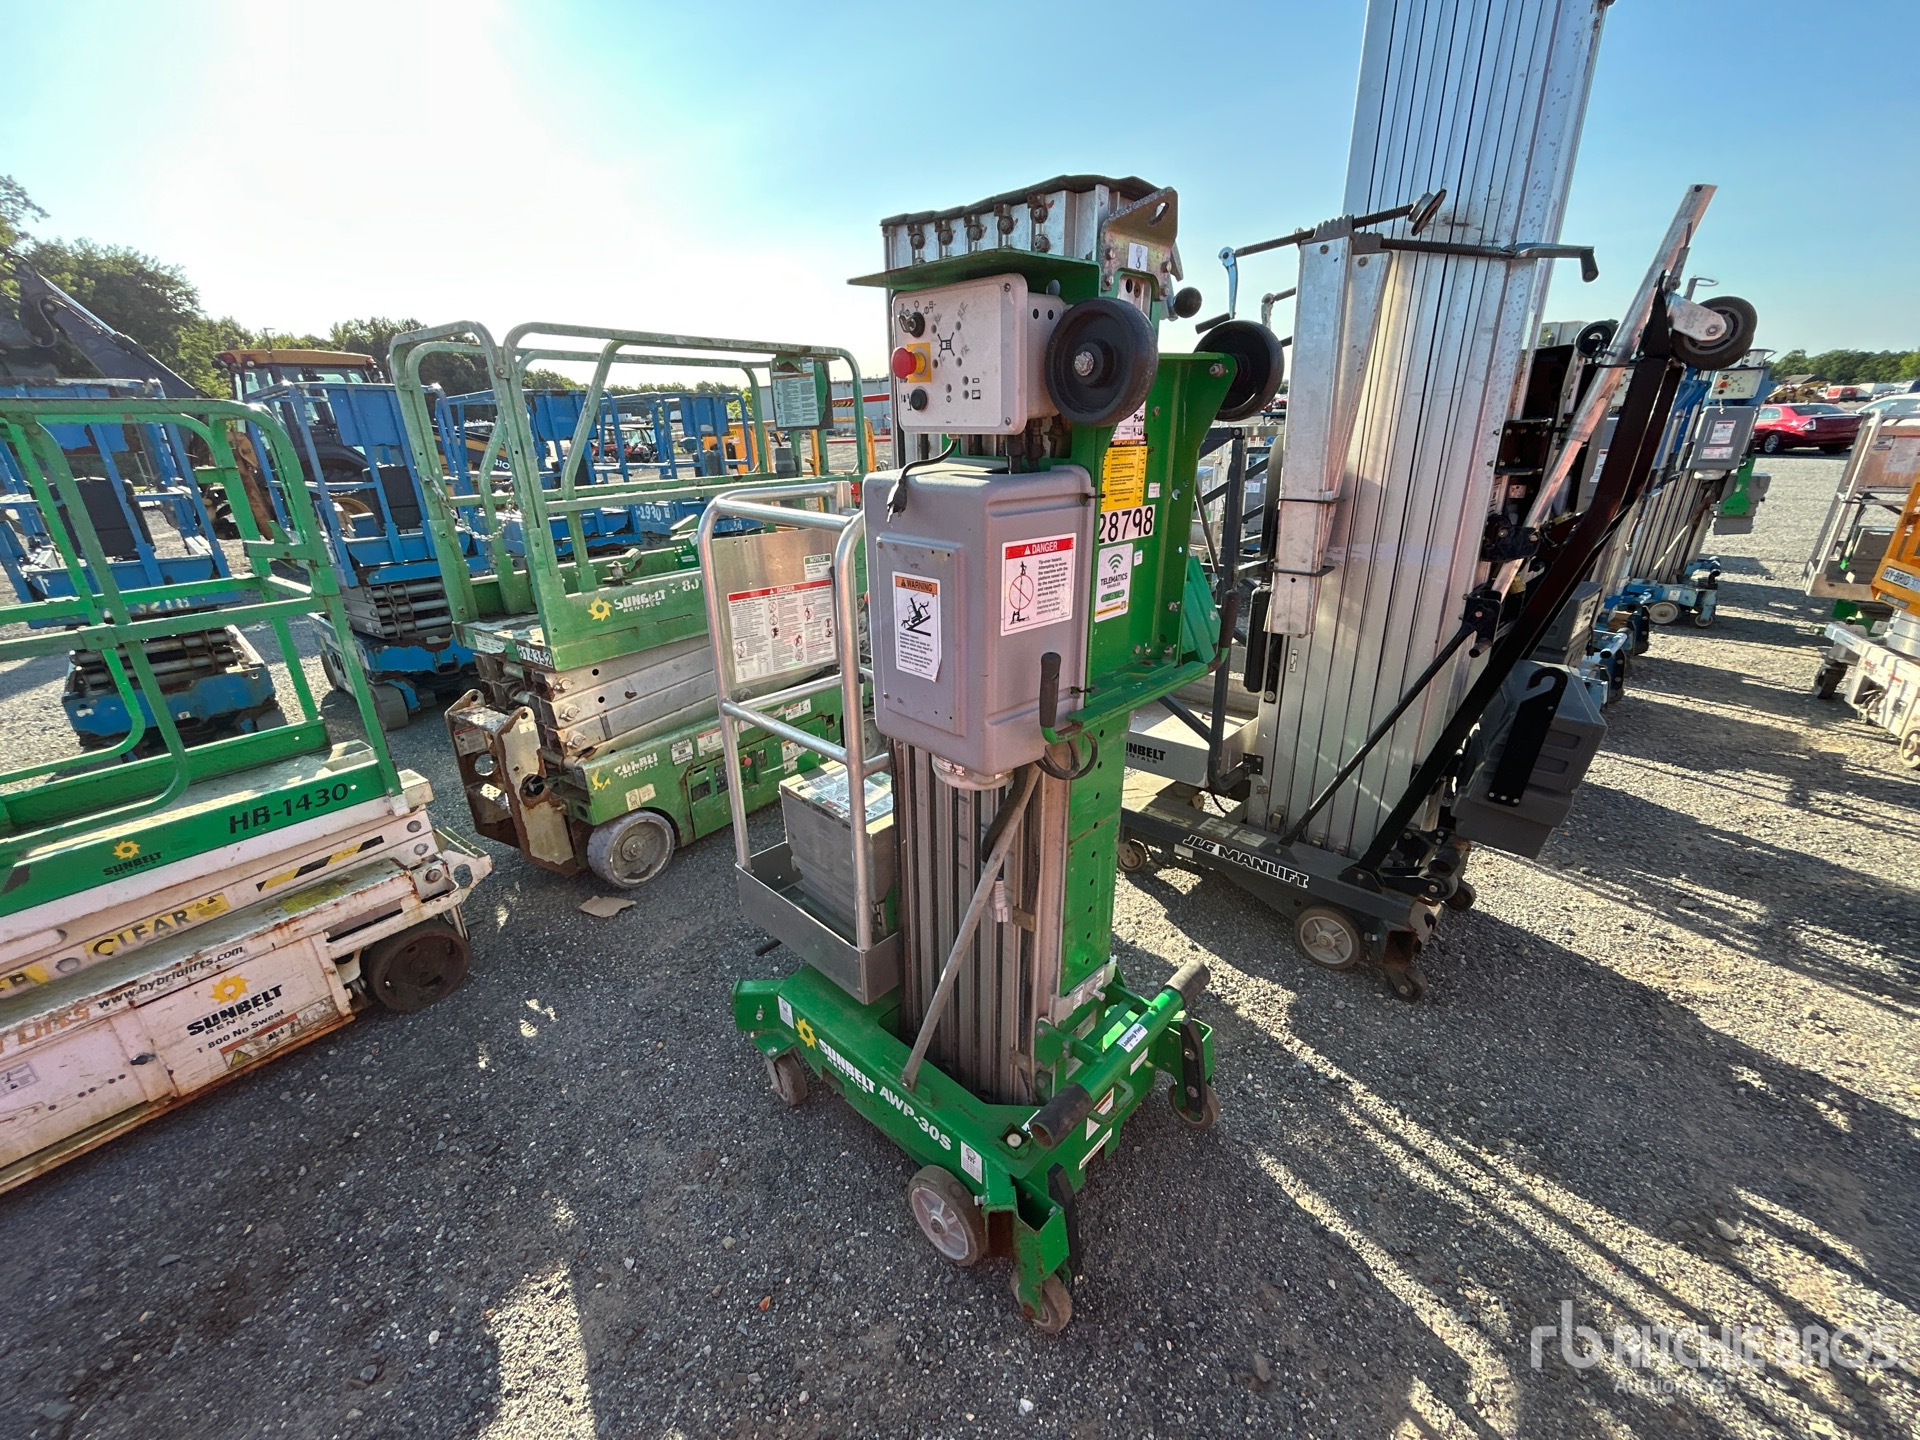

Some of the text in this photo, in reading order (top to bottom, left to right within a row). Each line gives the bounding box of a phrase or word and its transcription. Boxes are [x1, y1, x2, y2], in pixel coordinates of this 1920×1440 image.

[1031, 541, 1058, 554] DANGER
[906, 580, 933, 592] WARNING
[1100, 573, 1128, 586] TELEMATICS
[229, 782, 349, 834] HB-1430
[102, 851, 162, 876] SUNBELT
[1182, 833, 1309, 889] JLG MANLIFT
[92, 909, 192, 957] CLEAR
[186, 984, 283, 1036] SUNBELT
[204, 1001, 274, 1036] RENTALS
[207, 1034, 231, 1049] 800
[232, 1026, 249, 1037] No
[250, 1008, 286, 1029] Sweat
[817, 1037, 952, 1151] SUNBELT AWP-30S
[826, 1056, 868, 1093] RENTALS
